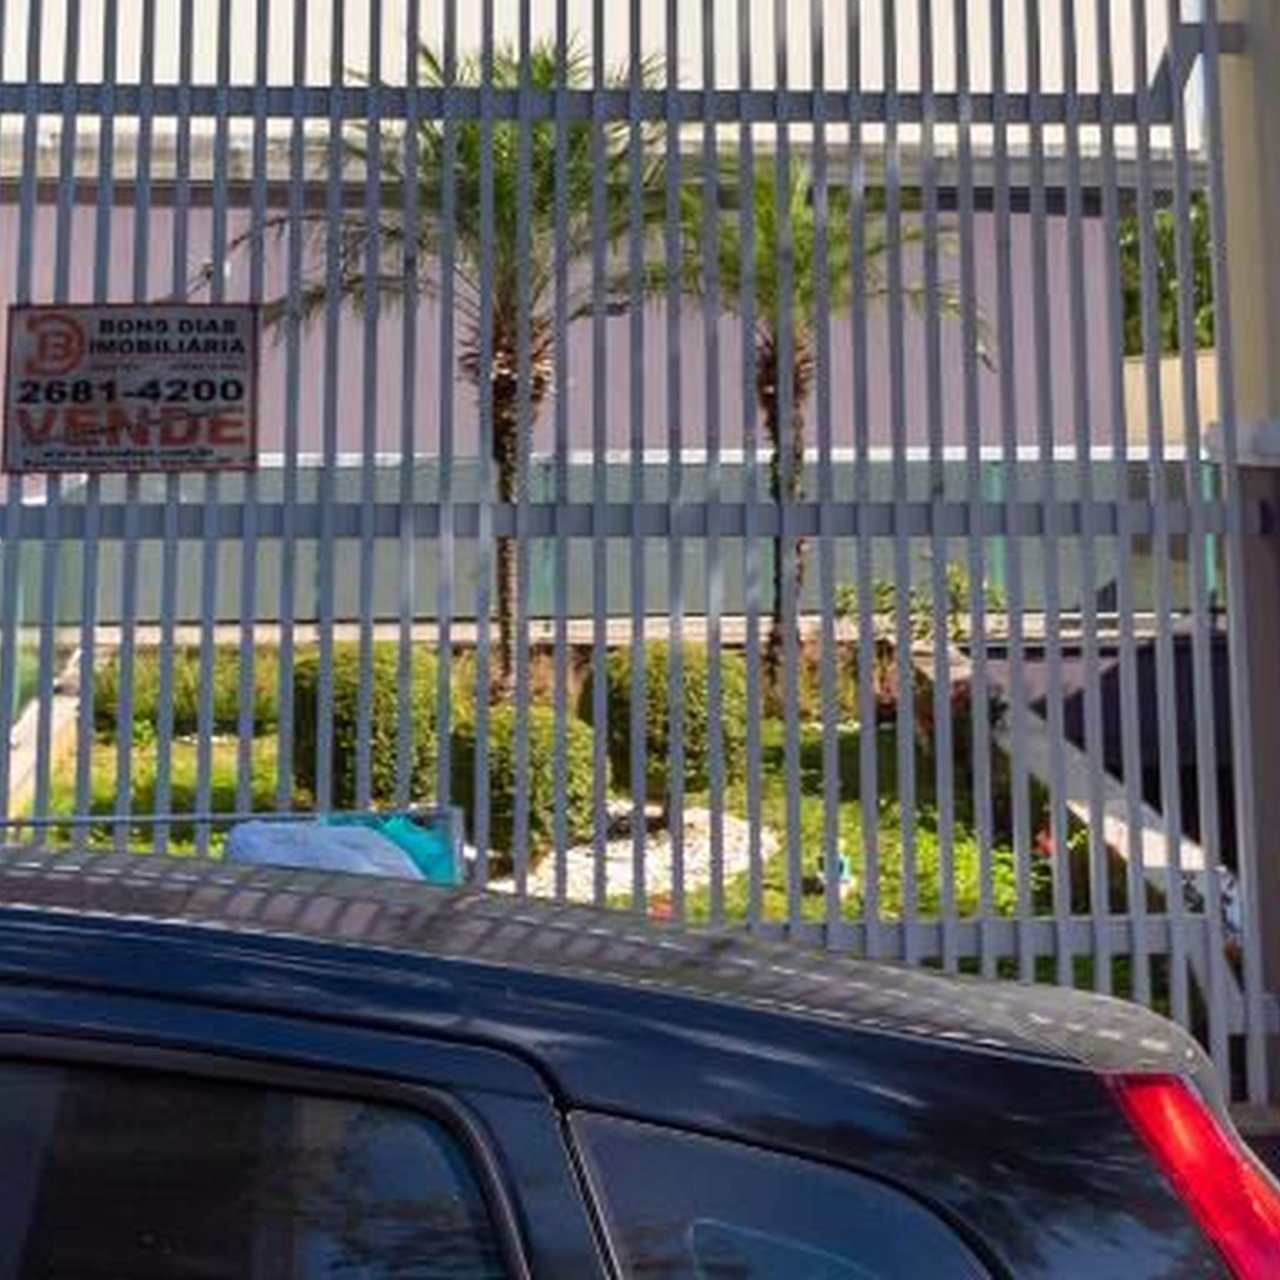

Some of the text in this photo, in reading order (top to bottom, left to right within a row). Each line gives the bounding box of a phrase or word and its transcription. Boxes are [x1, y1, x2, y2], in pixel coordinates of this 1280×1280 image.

[99, 319, 237, 333] BONS DIAS
[17, 379, 244, 404] 2681-4200
[16, 406, 246, 446] VENDE
